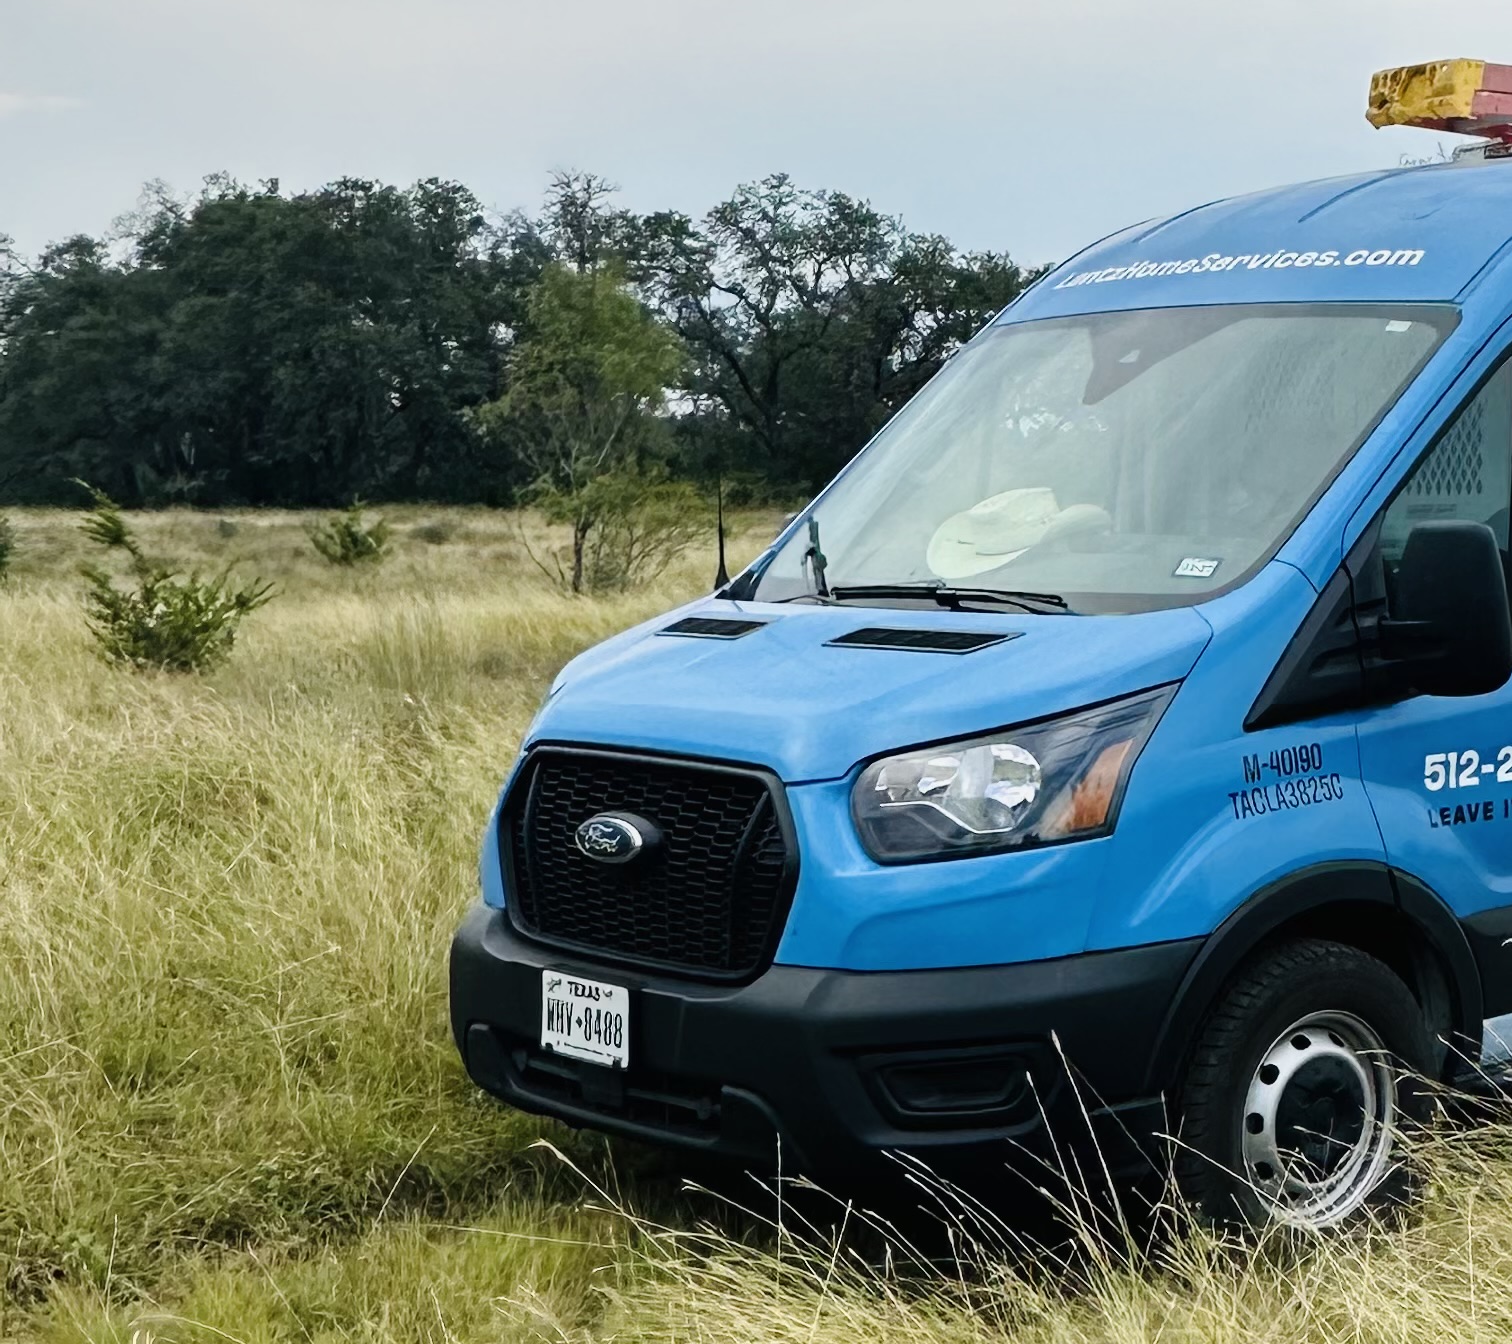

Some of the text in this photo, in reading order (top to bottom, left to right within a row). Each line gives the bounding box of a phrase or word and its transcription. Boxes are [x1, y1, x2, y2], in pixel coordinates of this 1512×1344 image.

[1050, 249, 1425, 290] LantzHomeServices.com
[1242, 743, 1322, 784] M-40190
[1427, 801, 1494, 829] LEAVE
